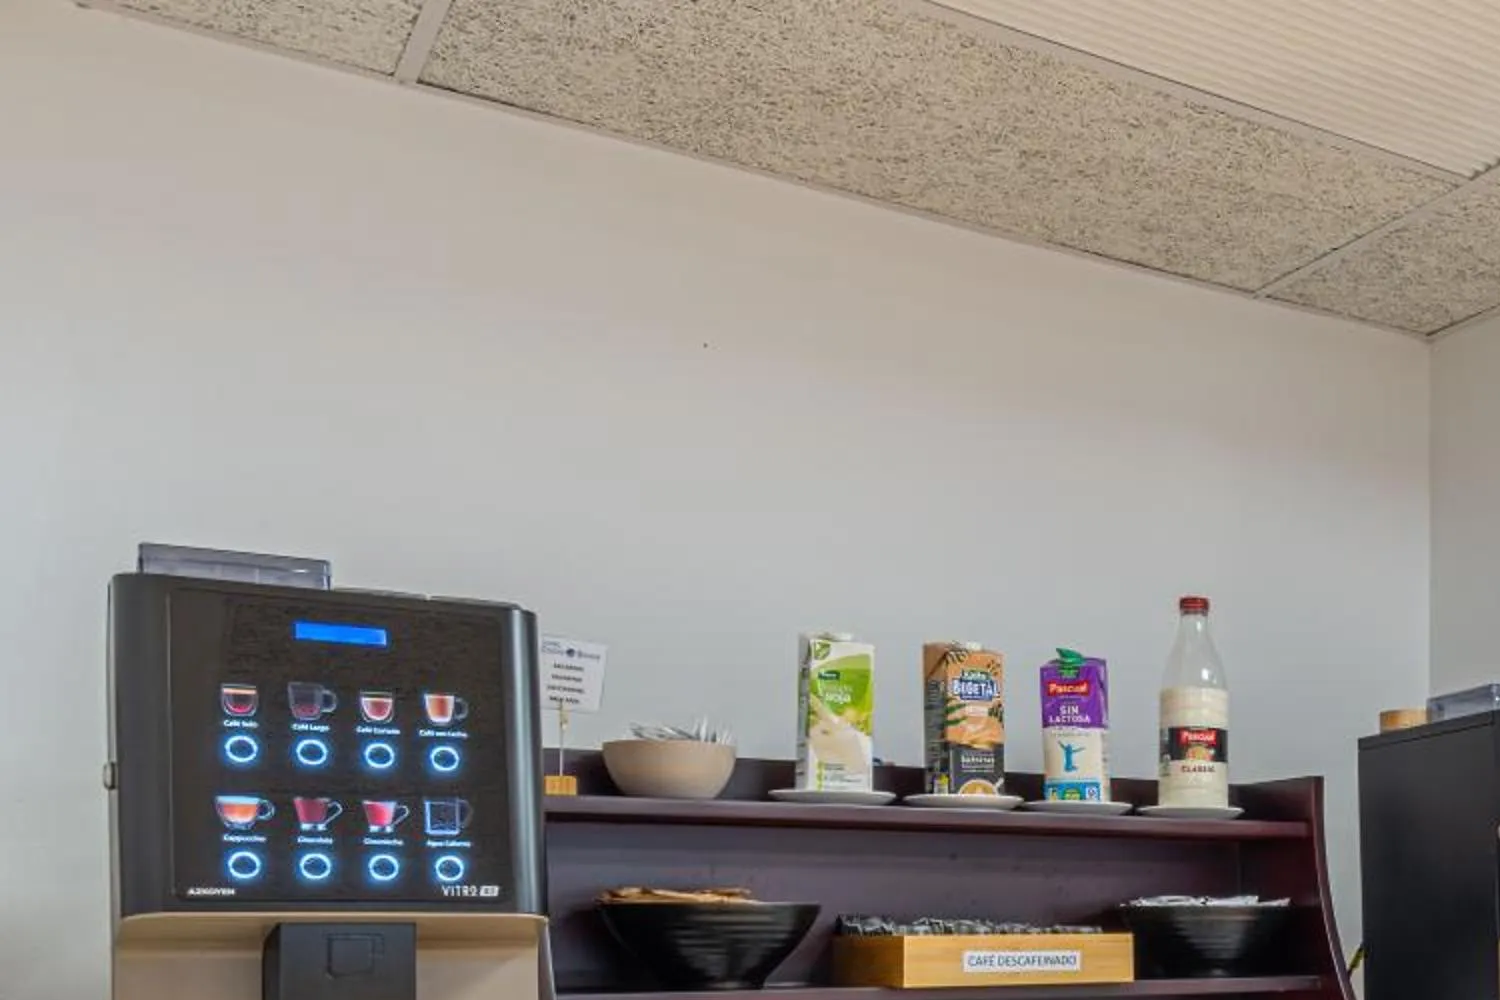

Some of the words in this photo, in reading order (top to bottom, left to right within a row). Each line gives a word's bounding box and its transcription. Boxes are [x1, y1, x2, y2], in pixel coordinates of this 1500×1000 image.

[1049, 682, 1088, 694] Pascual
[1060, 704, 1079, 716] SIN
[1048, 714, 1091, 724] LACTOSA
[967, 953, 996, 967] CAFÉ
[997, 954, 1077, 967] DESCAFEINADO
